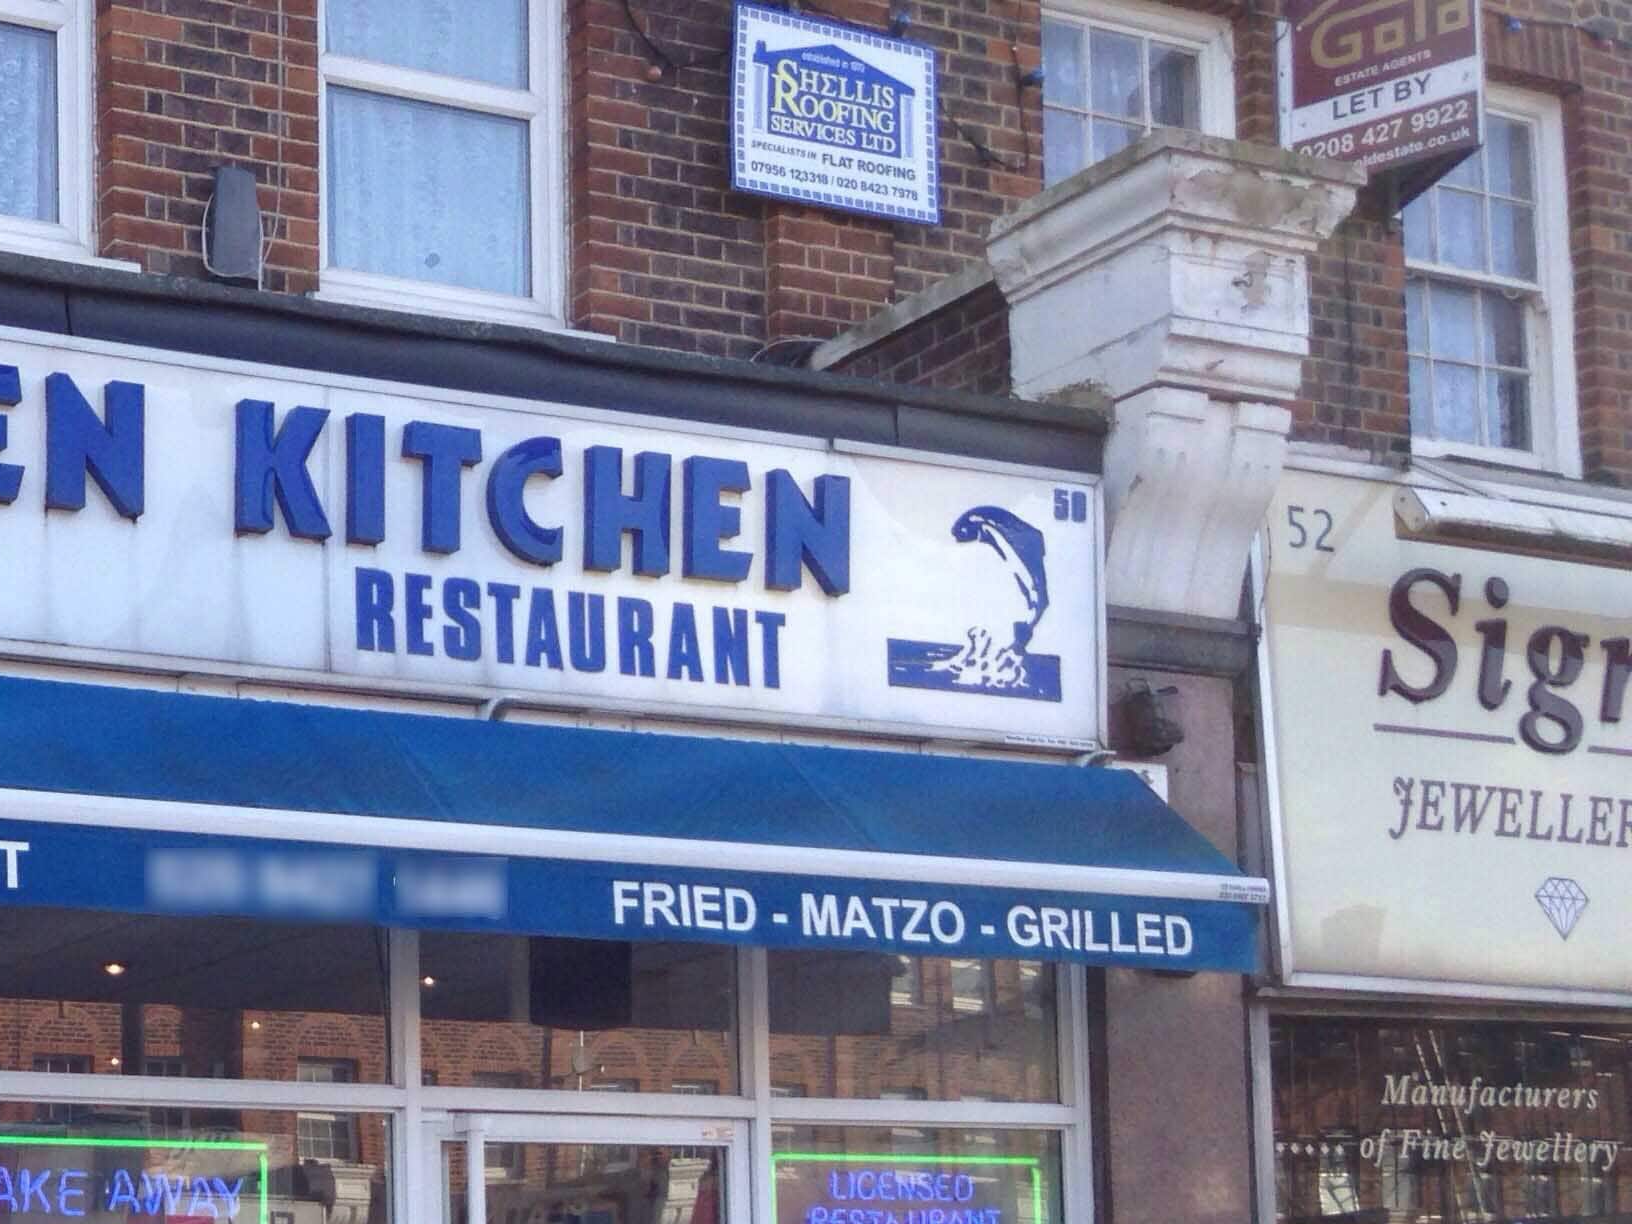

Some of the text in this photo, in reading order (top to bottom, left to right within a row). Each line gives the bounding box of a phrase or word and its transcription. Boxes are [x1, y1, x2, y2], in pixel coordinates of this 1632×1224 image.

[1335, 50, 1431, 86] ESTATE AGENTS
[771, 74, 895, 134] ROOFING
[1333, 73, 1432, 120] LET BY
[771, 115, 896, 153] SERVICES LTD
[1361, 118, 1402, 146] 427
[1411, 99, 1468, 133] 9922
[751, 140, 916, 181] SPECIALISTS IN FLAT ROOFING
[836, 177, 858, 191] 020
[861, 181, 888, 196] 8423
[234, 399, 851, 597] KITCHEN
[1052, 487, 1087, 523] 50
[1287, 505, 1335, 553] 52
[355, 566, 787, 690] RESTAURANT
[612, 880, 757, 932] FRIED
[801, 893, 965, 946] MATZO
[1005, 904, 1194, 957] GRILLED
[1380, 1074, 1599, 1113] Manufacturers
[1360, 1129, 1619, 1171] of Fine Jewellery
[108, 1167, 245, 1219] AWAY
[828, 1168, 975, 1202] LICENSED
